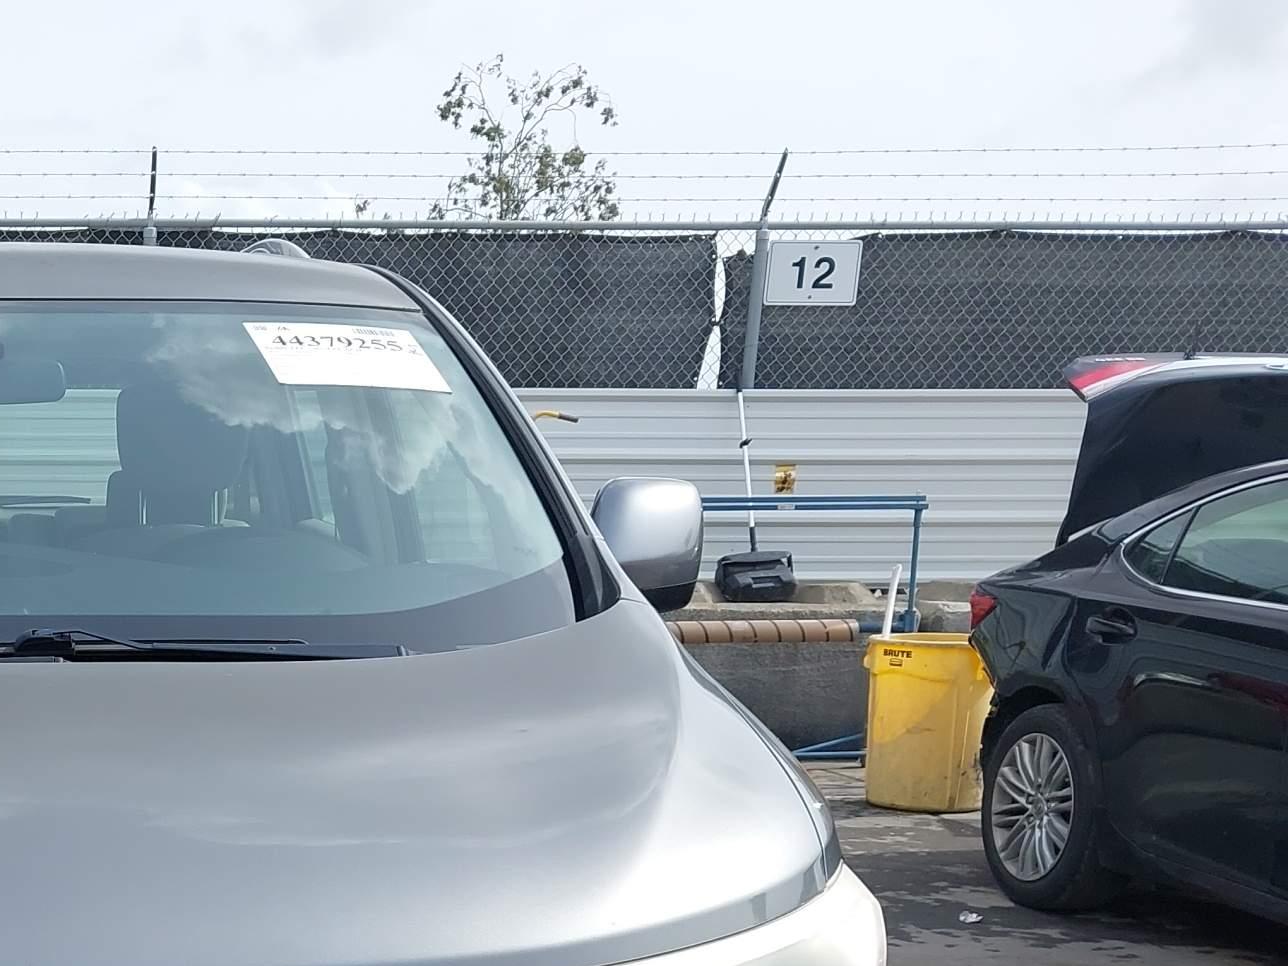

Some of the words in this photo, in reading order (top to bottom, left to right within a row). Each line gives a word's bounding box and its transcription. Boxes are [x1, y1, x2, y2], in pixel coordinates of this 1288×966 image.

[792, 256, 836, 289] 12
[272, 335, 403, 352] 44379255
[883, 648, 913, 659] BRUTE
